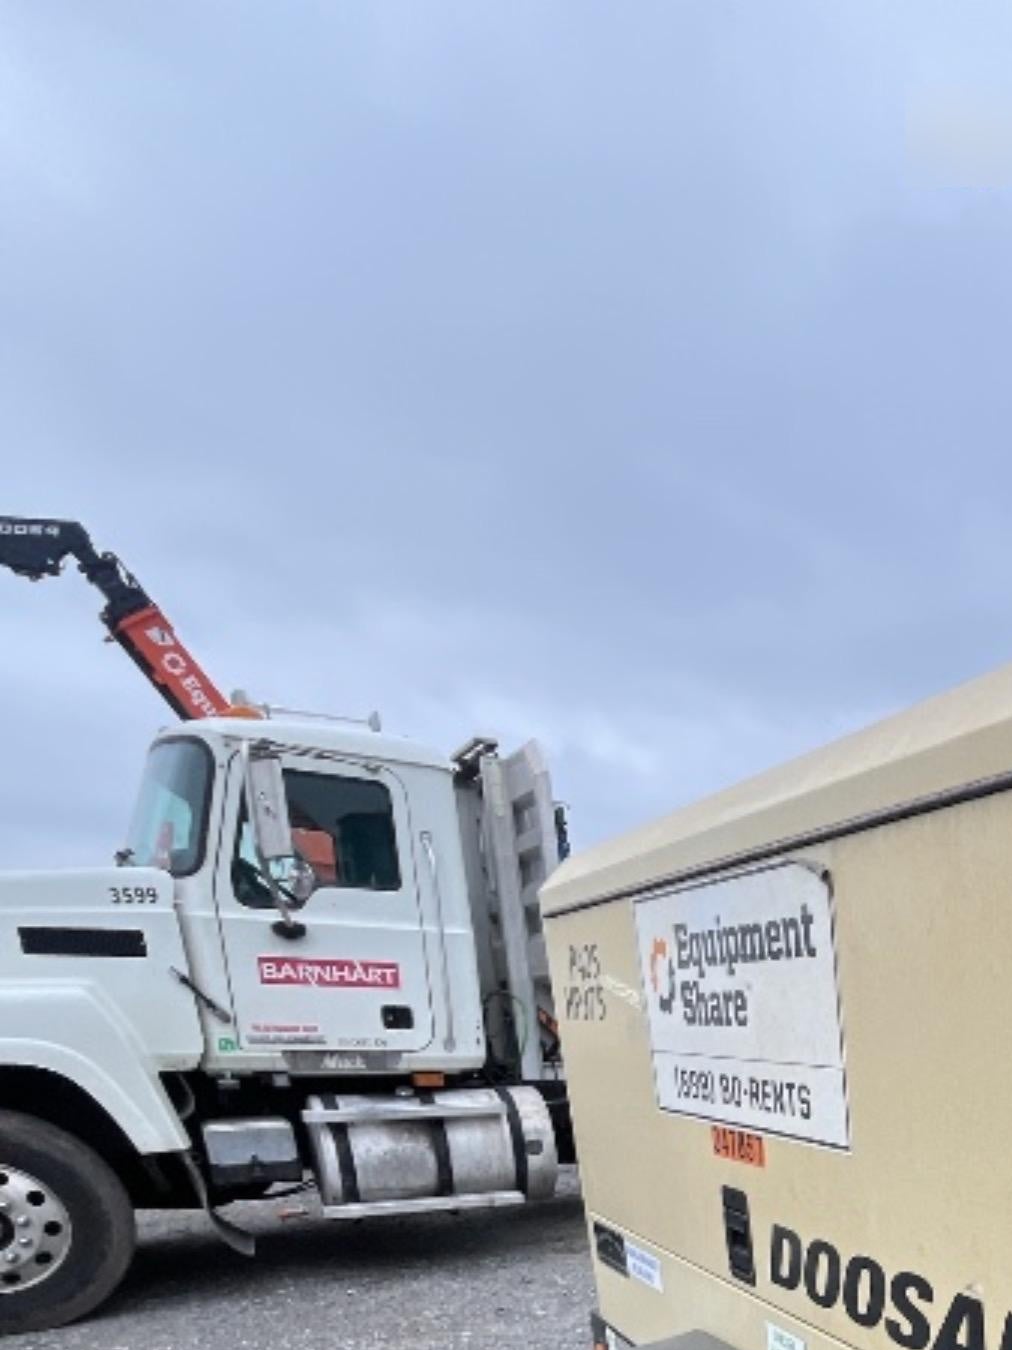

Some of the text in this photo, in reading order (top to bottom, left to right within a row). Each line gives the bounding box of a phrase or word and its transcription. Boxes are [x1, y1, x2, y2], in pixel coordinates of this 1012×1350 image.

[109, 886, 157, 905] 3599
[674, 903, 817, 978] Equipment
[261, 960, 397, 988] BARNHART
[680, 979, 750, 1027] Share
